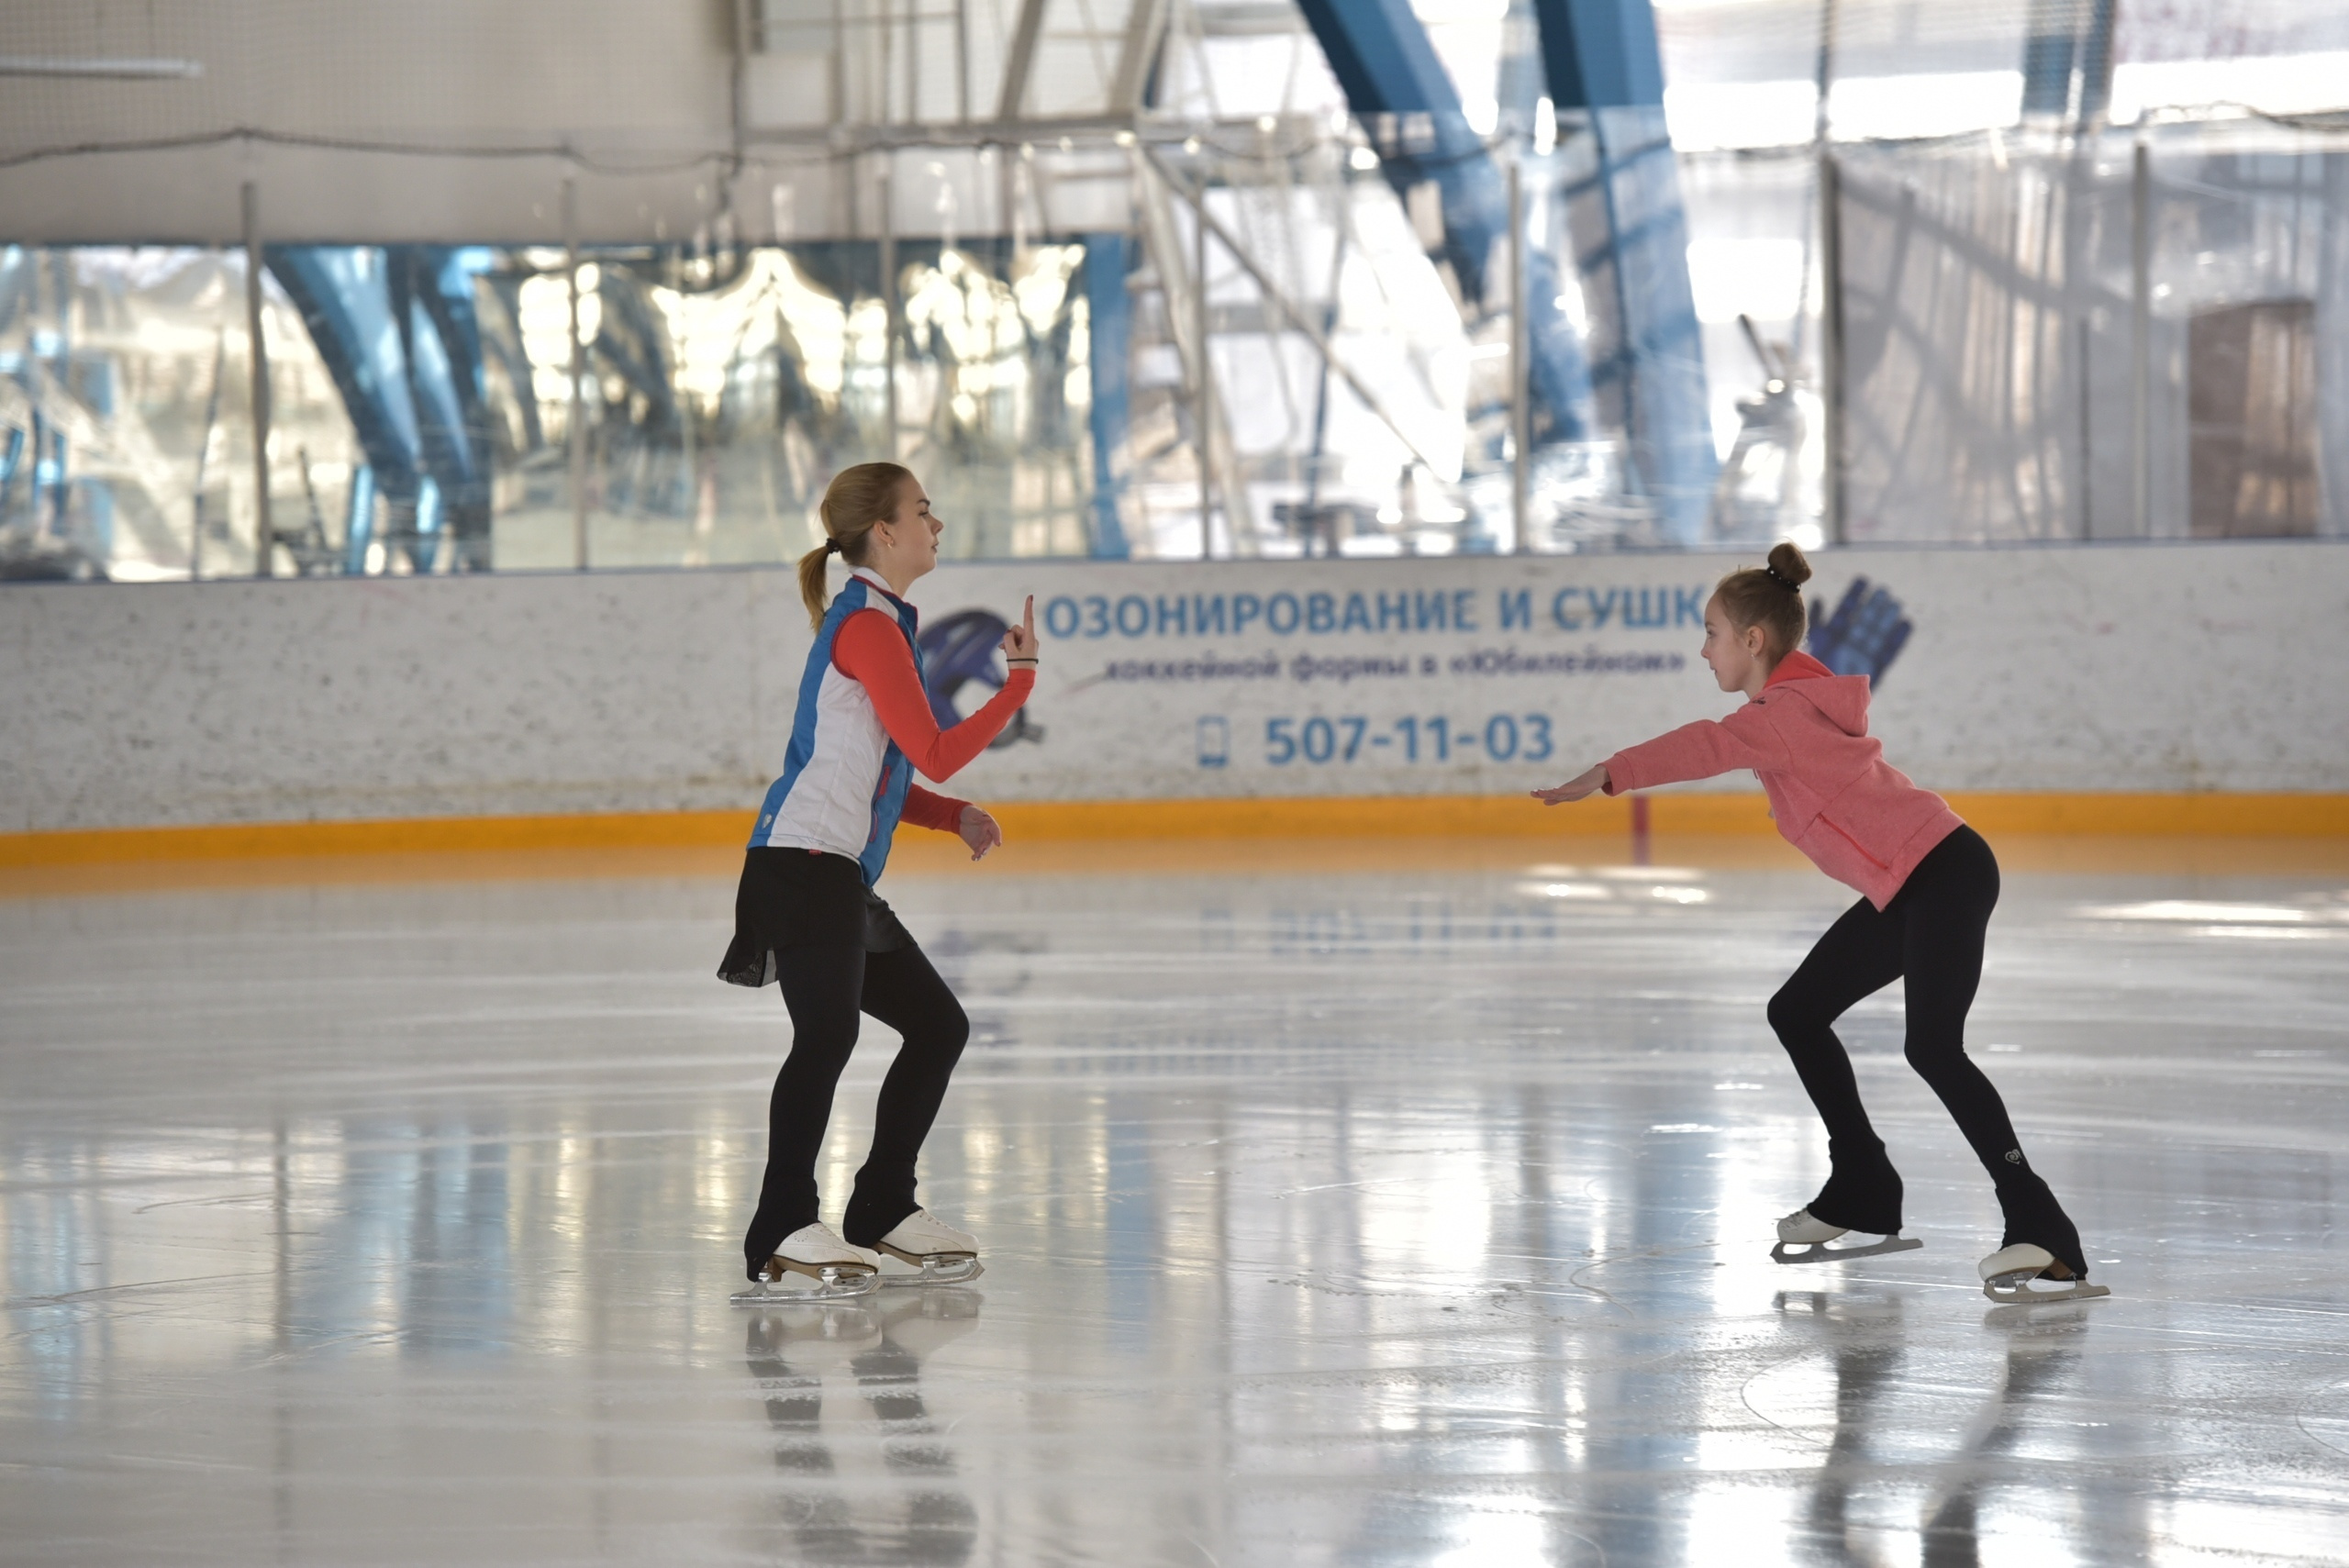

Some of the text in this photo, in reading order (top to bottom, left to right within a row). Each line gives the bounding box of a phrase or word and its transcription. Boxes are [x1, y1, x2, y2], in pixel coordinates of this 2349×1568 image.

[1044, 589, 1478, 639] ОЗОНИРОВАНИЕ
[1499, 587, 1533, 630] И
[1289, 651, 1408, 685] формы
[1419, 654, 1440, 677] в
[1264, 713, 1553, 765] 507-11-03
